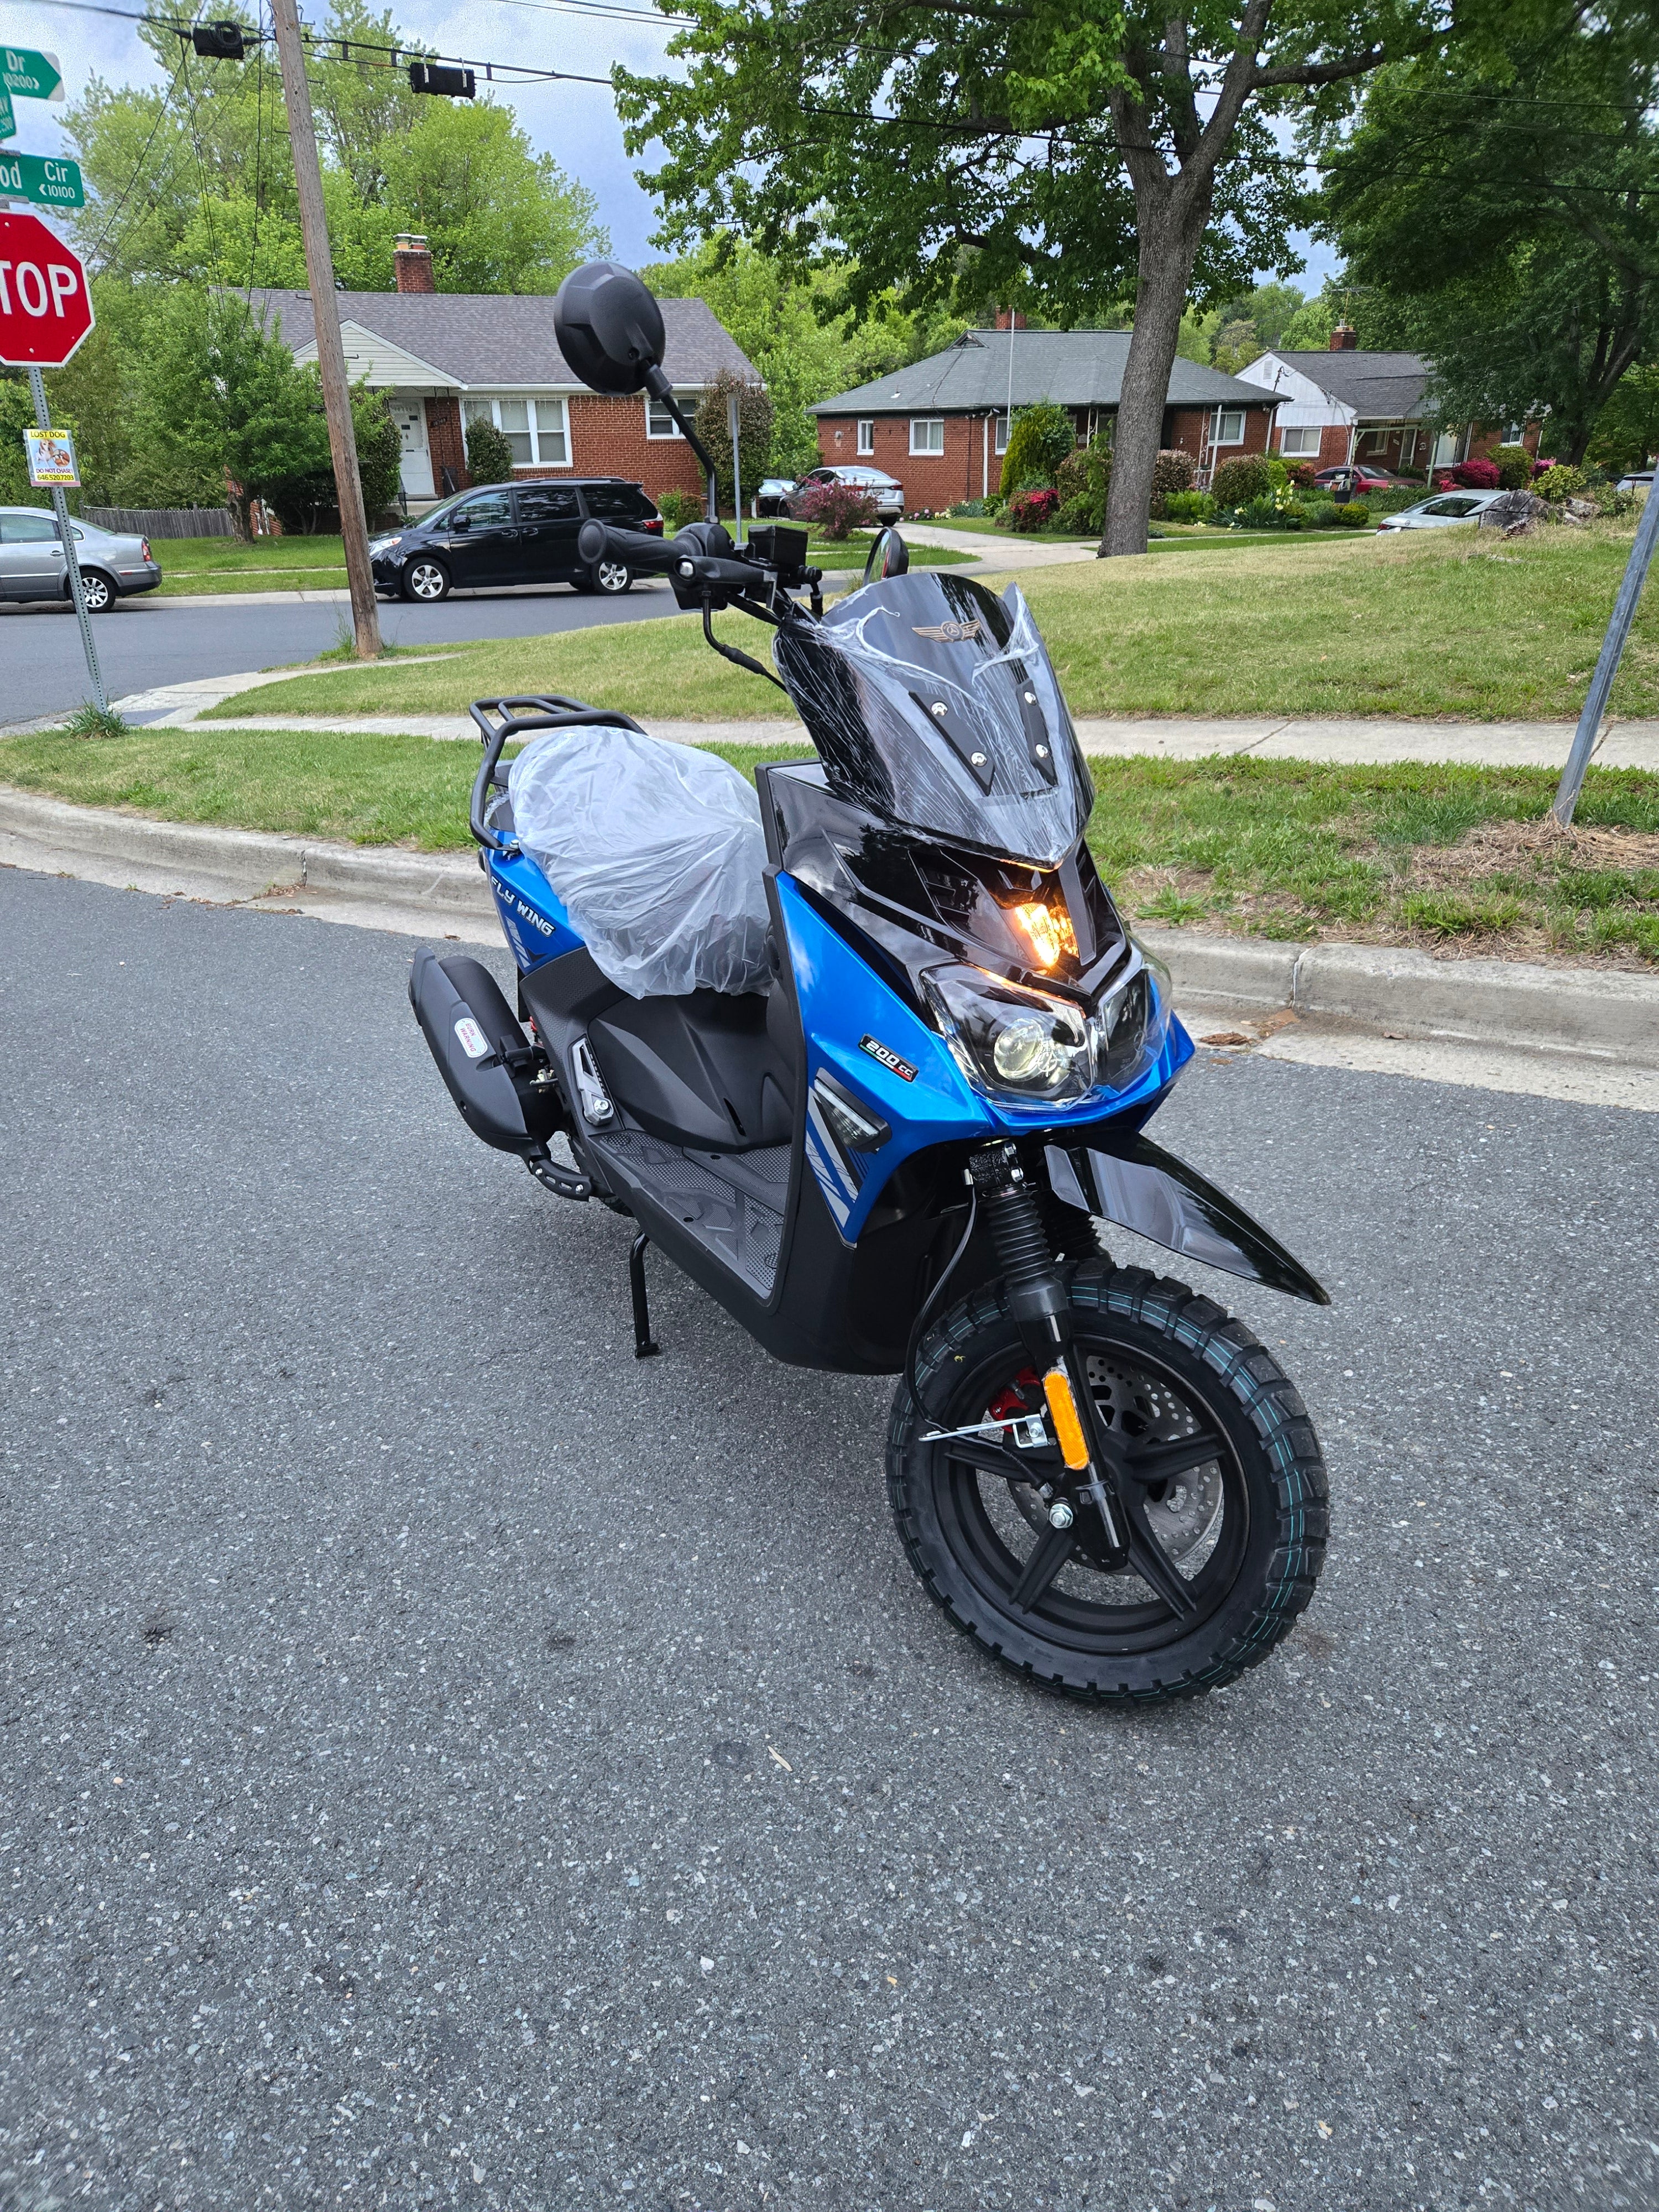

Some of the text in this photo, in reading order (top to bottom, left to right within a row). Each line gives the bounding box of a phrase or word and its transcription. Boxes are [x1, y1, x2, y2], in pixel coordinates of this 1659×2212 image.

[6, 50, 25, 73] Dr
[44, 160, 68, 182] Cir
[0, 260, 78, 317] TOP
[491, 875, 555, 937] FLY WING
[460, 1027, 476, 1052] WARNING
[466, 1023, 476, 1036] BURN
